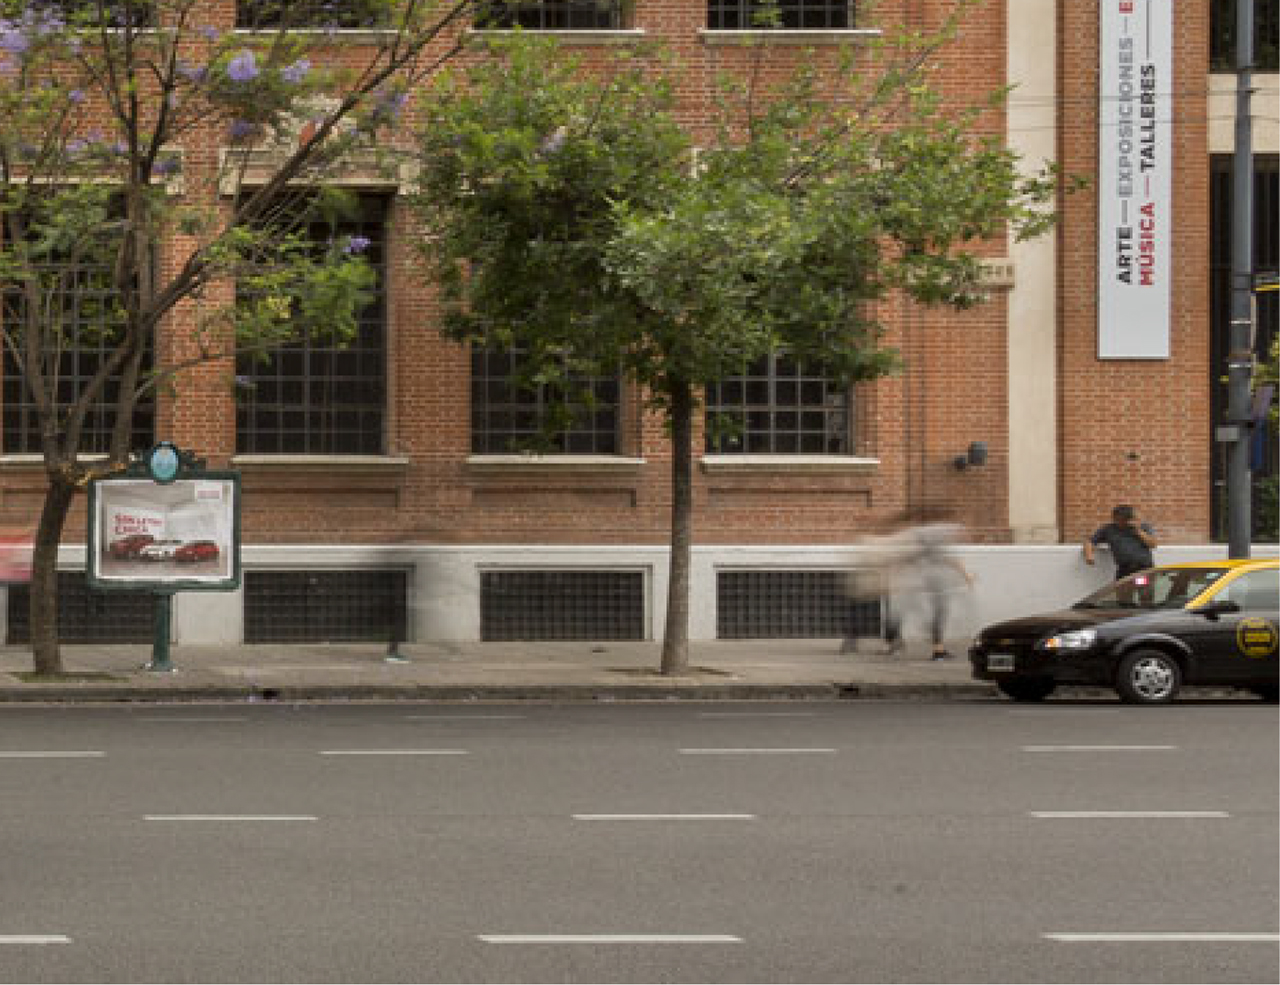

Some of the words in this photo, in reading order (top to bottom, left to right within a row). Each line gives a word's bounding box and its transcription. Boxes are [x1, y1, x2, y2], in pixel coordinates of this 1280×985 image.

[1117, 37, 1133, 197] EXPOSICIONES
[1139, 65, 1155, 173] TALLERES
[1116, 227, 1132, 285] ARTE
[1135, 202, 1155, 285] MÚSICA
